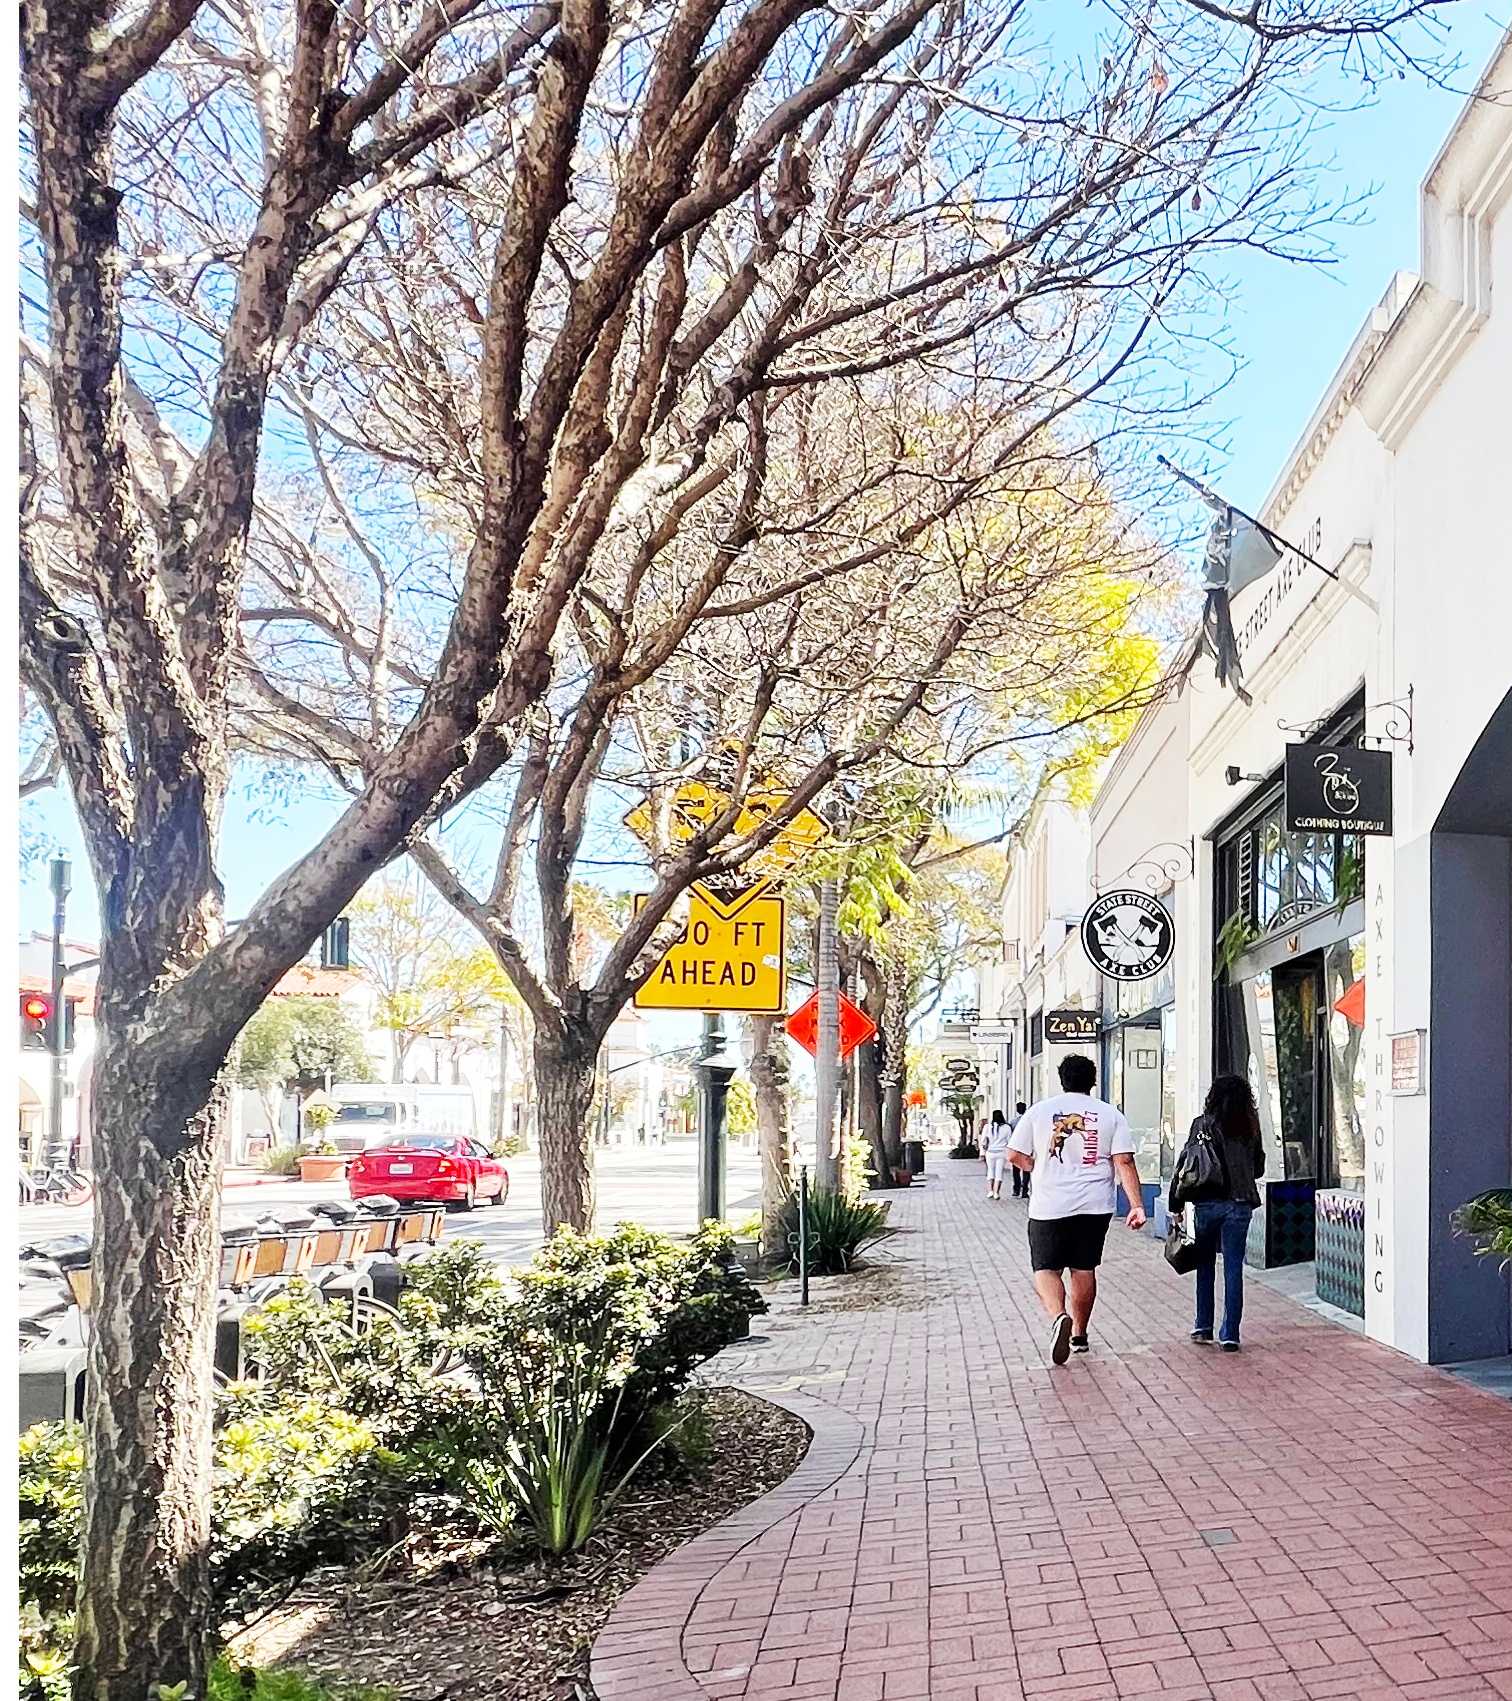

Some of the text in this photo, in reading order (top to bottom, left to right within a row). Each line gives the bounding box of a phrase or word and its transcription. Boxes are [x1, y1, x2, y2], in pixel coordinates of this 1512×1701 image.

[1246, 517, 1321, 649] STREET AXE CLUB
[1295, 817, 1384, 831] CLOTHING BOUTIQUE
[1096, 895, 1161, 916] STATE STREET
[734, 922, 765, 946] FT
[1375, 885, 1384, 978] AXE
[660, 960, 756, 986] AHEAD
[1100, 954, 1162, 976] AXE CLUB
[1050, 1016, 1099, 1033] Zen Yai
[1374, 1018, 1385, 1293] THROWING
